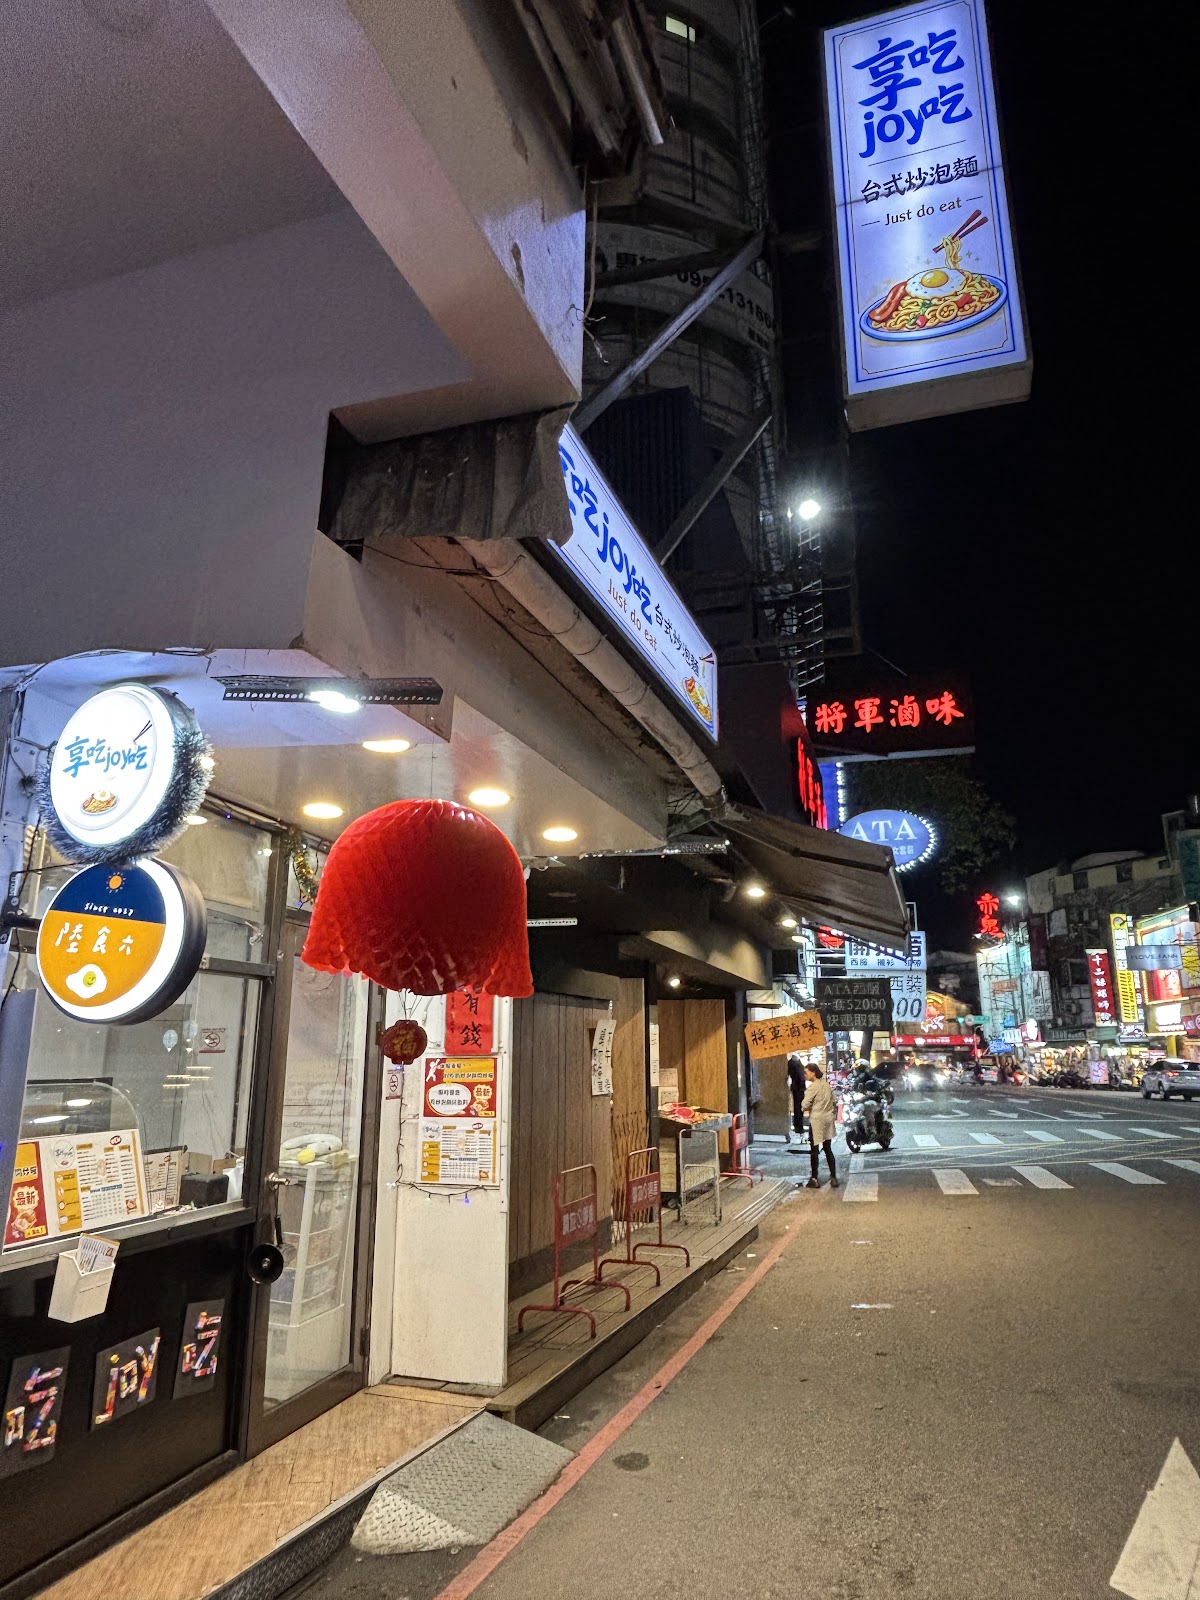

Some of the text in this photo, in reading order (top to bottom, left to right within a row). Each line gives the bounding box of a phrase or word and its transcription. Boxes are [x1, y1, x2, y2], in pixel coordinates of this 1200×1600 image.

[852, 29, 964, 111] 享吃
[859, 83, 972, 158] joy吃
[861, 155, 979, 204] 台式炒泡麵
[884, 196, 963, 227] Just do eat
[607, 578, 657, 652] Just do eat
[653, 603, 700, 678] 台式炒泡麵
[814, 691, 965, 734] 將軍滷味
[62, 735, 148, 778] 享吃joy吃
[851, 818, 918, 842] ATA
[751, 1018, 819, 1046] 將軍滷味
[4, 1365, 64, 1452] 吃
